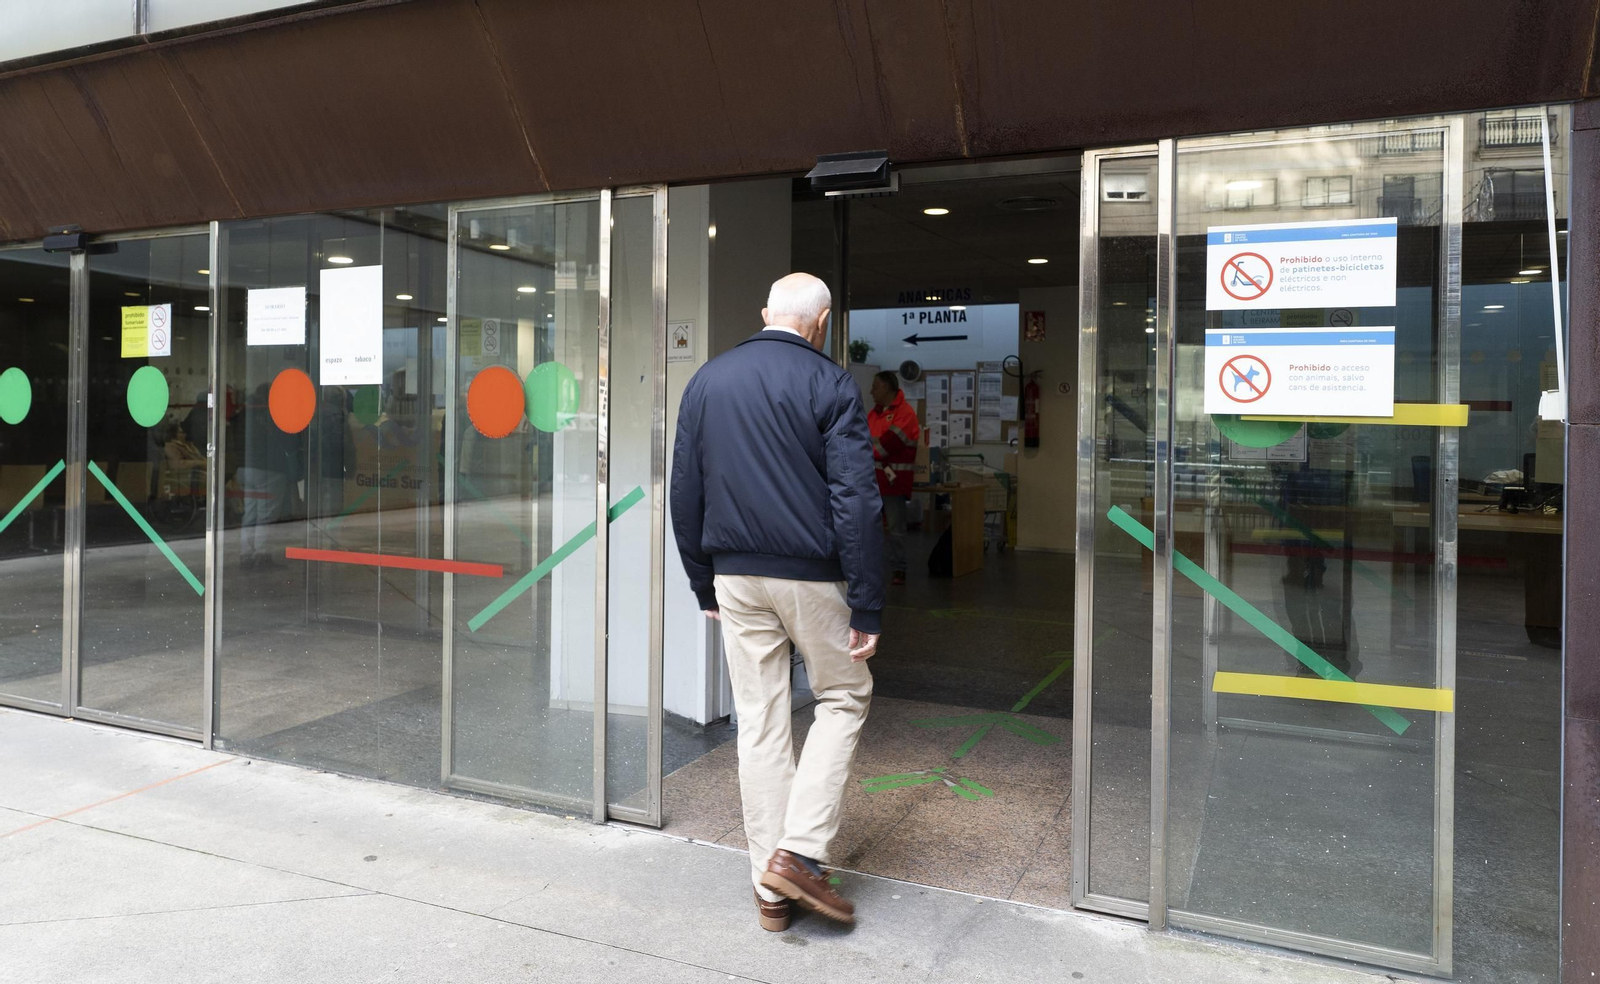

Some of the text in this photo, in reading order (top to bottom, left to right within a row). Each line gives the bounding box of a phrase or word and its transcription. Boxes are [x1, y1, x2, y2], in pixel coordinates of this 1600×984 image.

[1280, 256, 1323, 264] Prohibido
[1280, 263, 1385, 274] de patinetes-bicicletas
[1280, 274, 1321, 283] eléctricos
[1280, 284, 1323, 292] eléctricos.
[902, 310, 967, 325] 1ª PLANTA
[355, 355, 372, 363] tabaco
[1306, 374, 1340, 382] animais,
[1342, 373, 1365, 381] salvo
[1309, 383, 1320, 391] de
[1322, 383, 1367, 391] asistencia.
[356, 473, 424, 490] Galicia Sur
